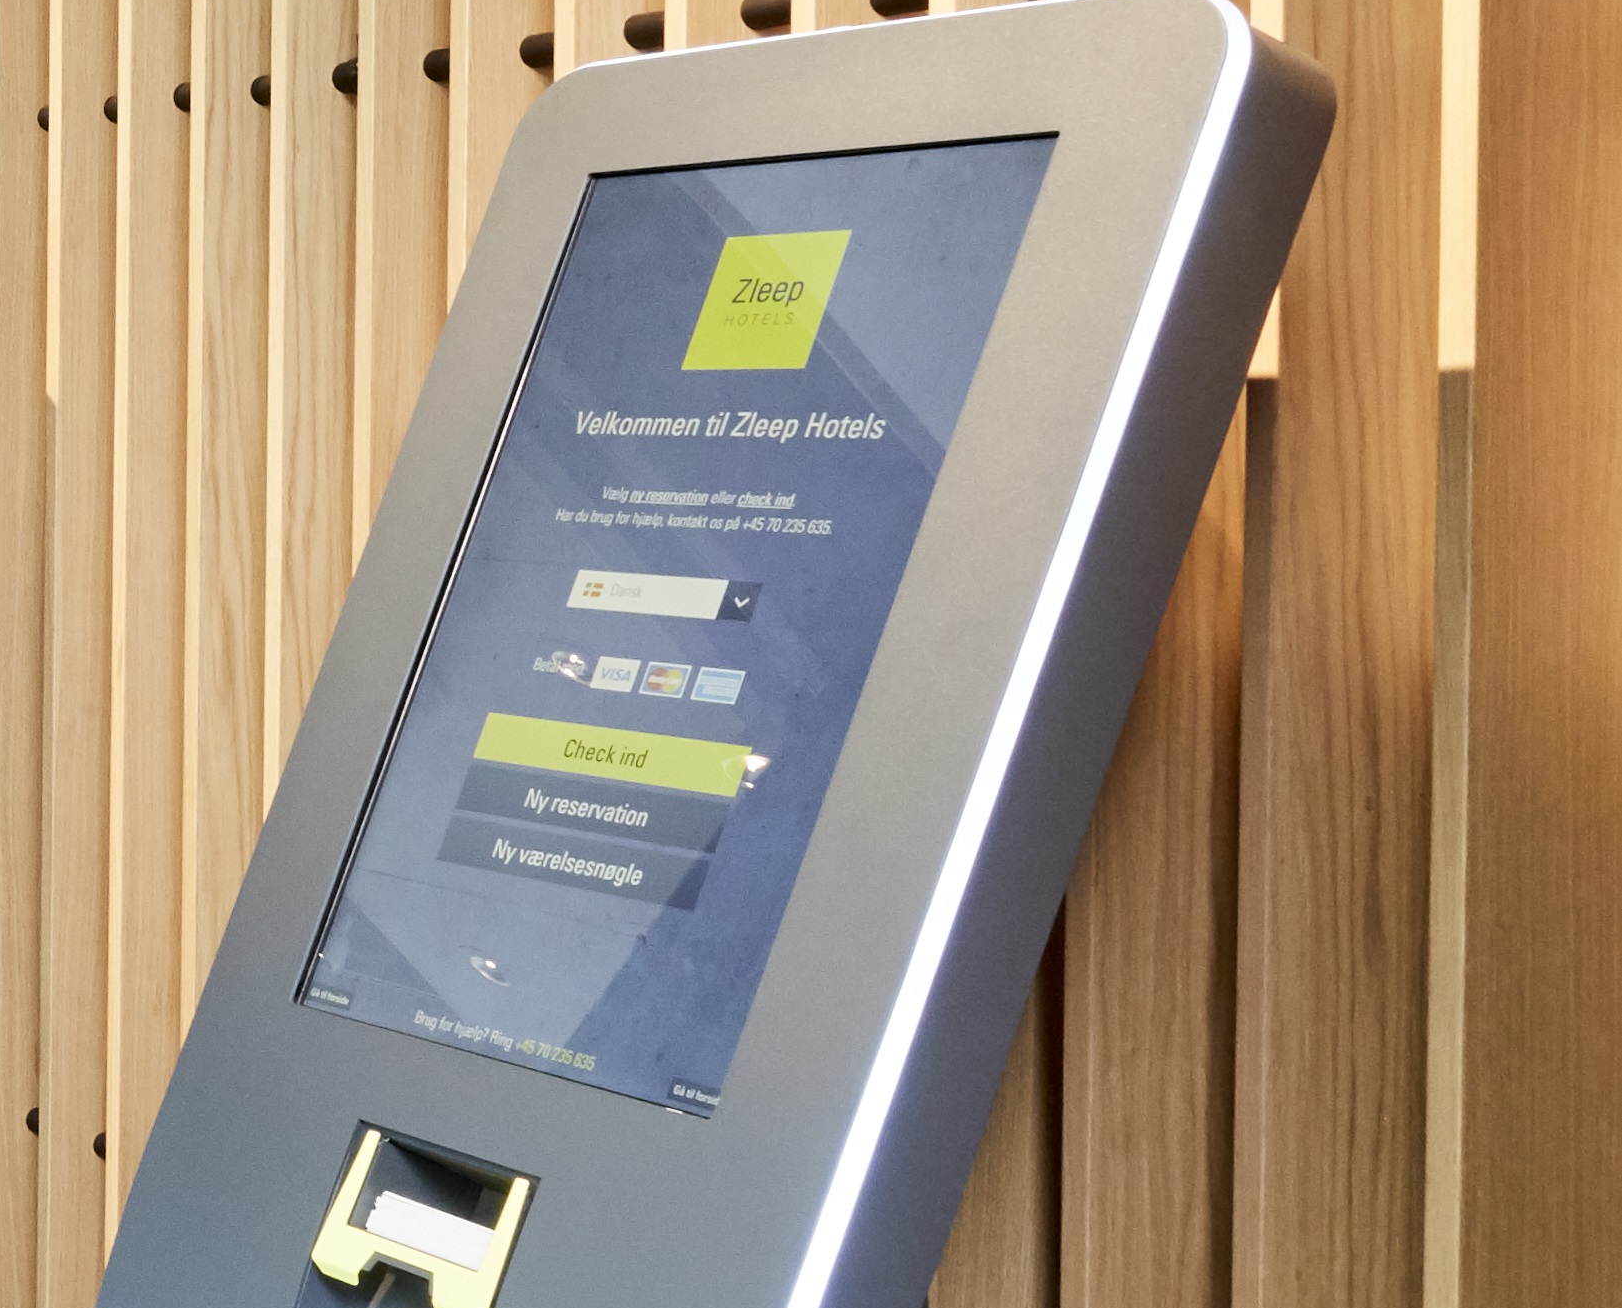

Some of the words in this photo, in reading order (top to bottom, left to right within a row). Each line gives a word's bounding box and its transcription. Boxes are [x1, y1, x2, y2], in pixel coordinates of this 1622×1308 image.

[732, 278, 804, 307] Zleep
[724, 312, 794, 326] HOTELS
[575, 411, 700, 437] Velkommen
[706, 412, 728, 437] til
[730, 411, 799, 443] Zleep
[803, 412, 886, 440] Hotels
[628, 490, 646, 504] ny
[645, 490, 709, 504] reservation
[710, 491, 737, 505] eller
[737, 491, 774, 506] check
[555, 508, 574, 522] Har
[574, 509, 590, 523] du
[589, 510, 614, 526] brug
[614, 511, 632, 524] for
[667, 513, 709, 528] kontakt
[709, 518, 724, 530] os
[723, 516, 742, 532] på
[742, 516, 766, 532] +45
[765, 517, 783, 532] 70
[781, 518, 808, 533] 235
[610, 582, 642, 598] Dansk
[600, 667, 631, 682] VISA
[563, 738, 615, 764] Check
[619, 747, 649, 769] ind
[523, 788, 551, 811] Ny
[550, 793, 649, 828] reservation
[492, 839, 519, 865] Ny
[519, 848, 643, 887] værelsesnøgle
[414, 1009, 438, 1031] Brug
[438, 1016, 454, 1032] for
[489, 1030, 514, 1052] Ring
[535, 1042, 551, 1059] 70
[551, 1046, 574, 1065] 235
[573, 1052, 597, 1072] 635
